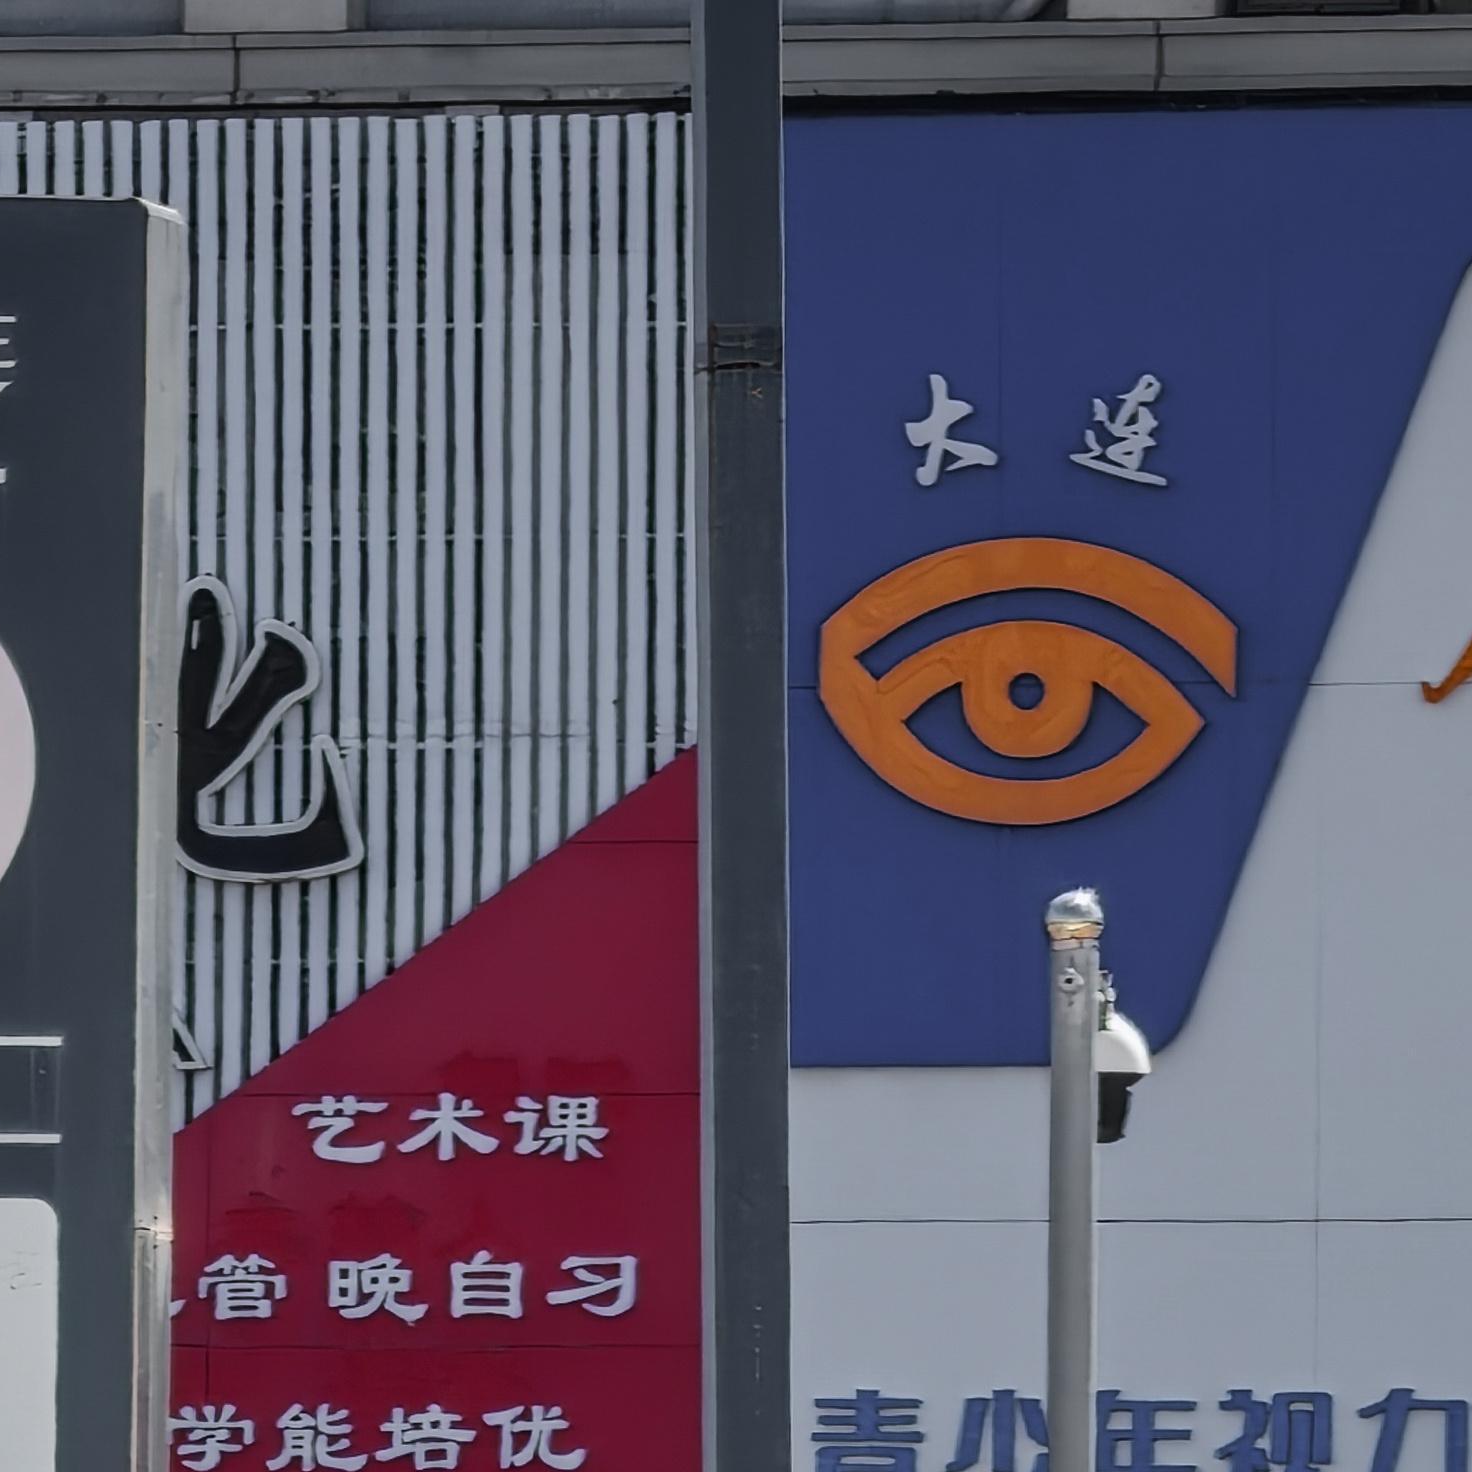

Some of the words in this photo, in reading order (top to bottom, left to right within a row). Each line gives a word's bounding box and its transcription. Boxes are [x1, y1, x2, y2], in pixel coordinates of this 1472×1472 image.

[904, 373, 1168, 487] 大连
[291, 1092, 610, 1164] 艺术课
